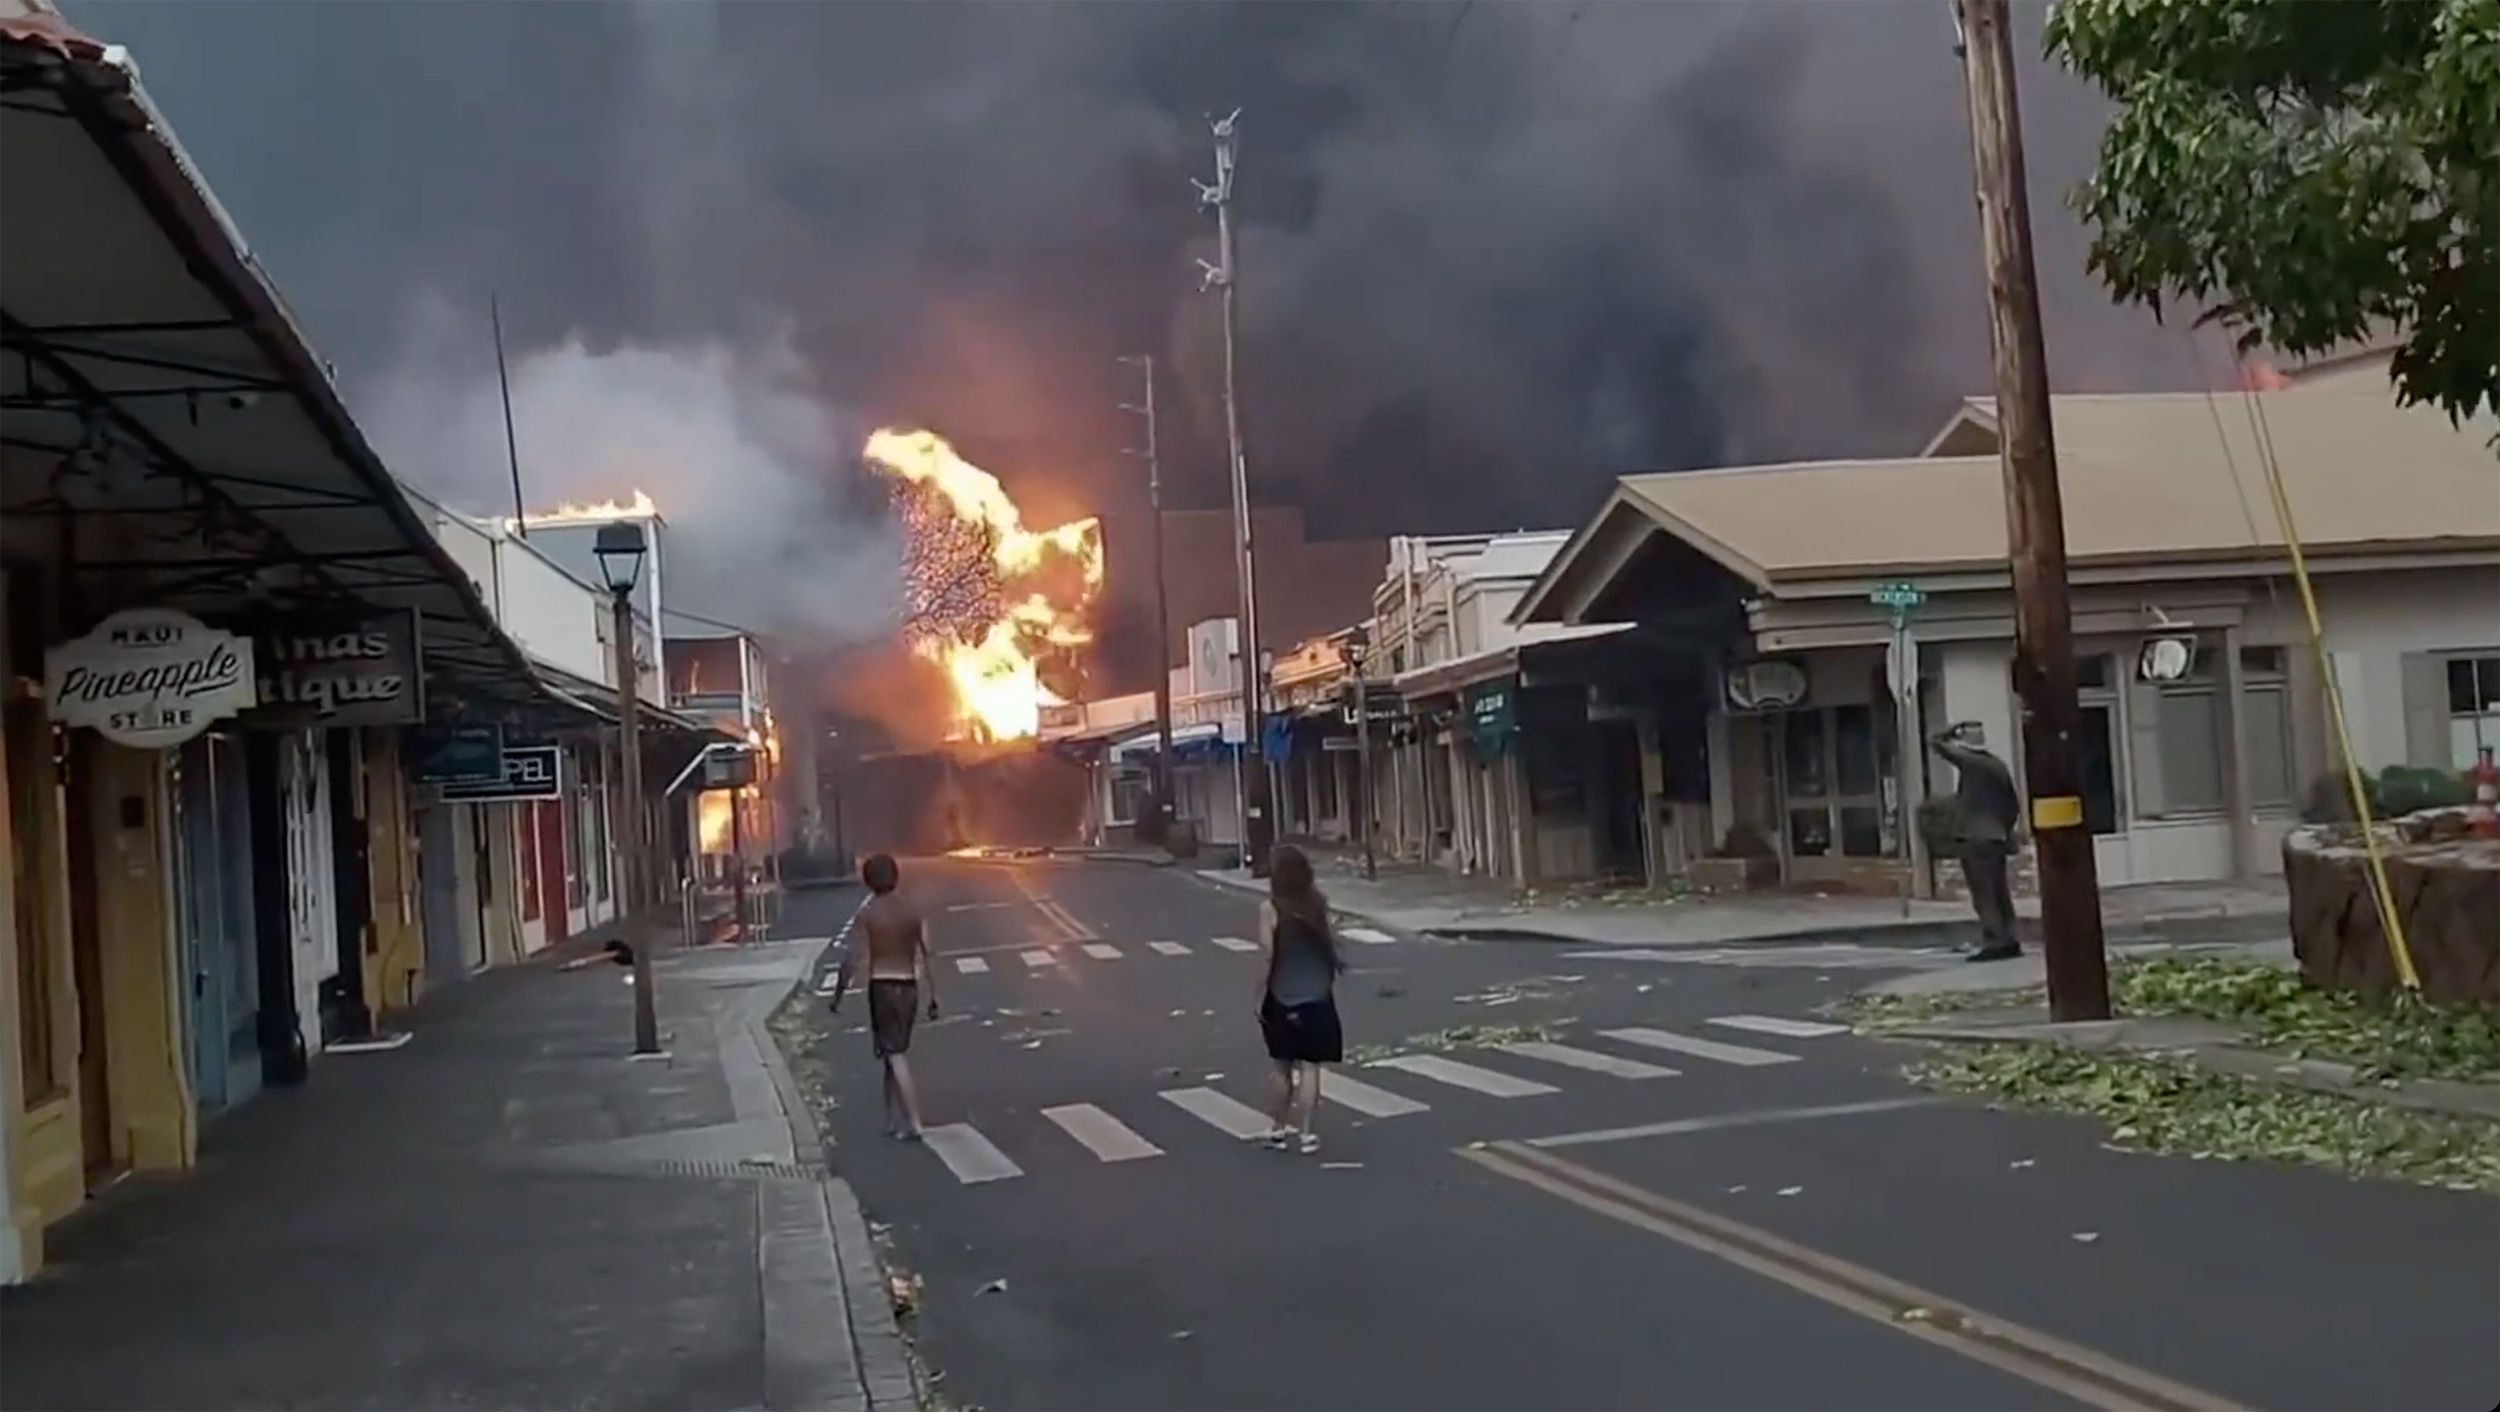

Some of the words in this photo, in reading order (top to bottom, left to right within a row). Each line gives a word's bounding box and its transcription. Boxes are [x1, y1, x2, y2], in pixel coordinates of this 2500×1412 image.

[112, 627, 182, 643] MAUI
[272, 631, 388, 660] inas
[57, 642, 238, 704] Pineapple
[258, 674, 402, 713] tique
[503, 757, 553, 781] PEL
